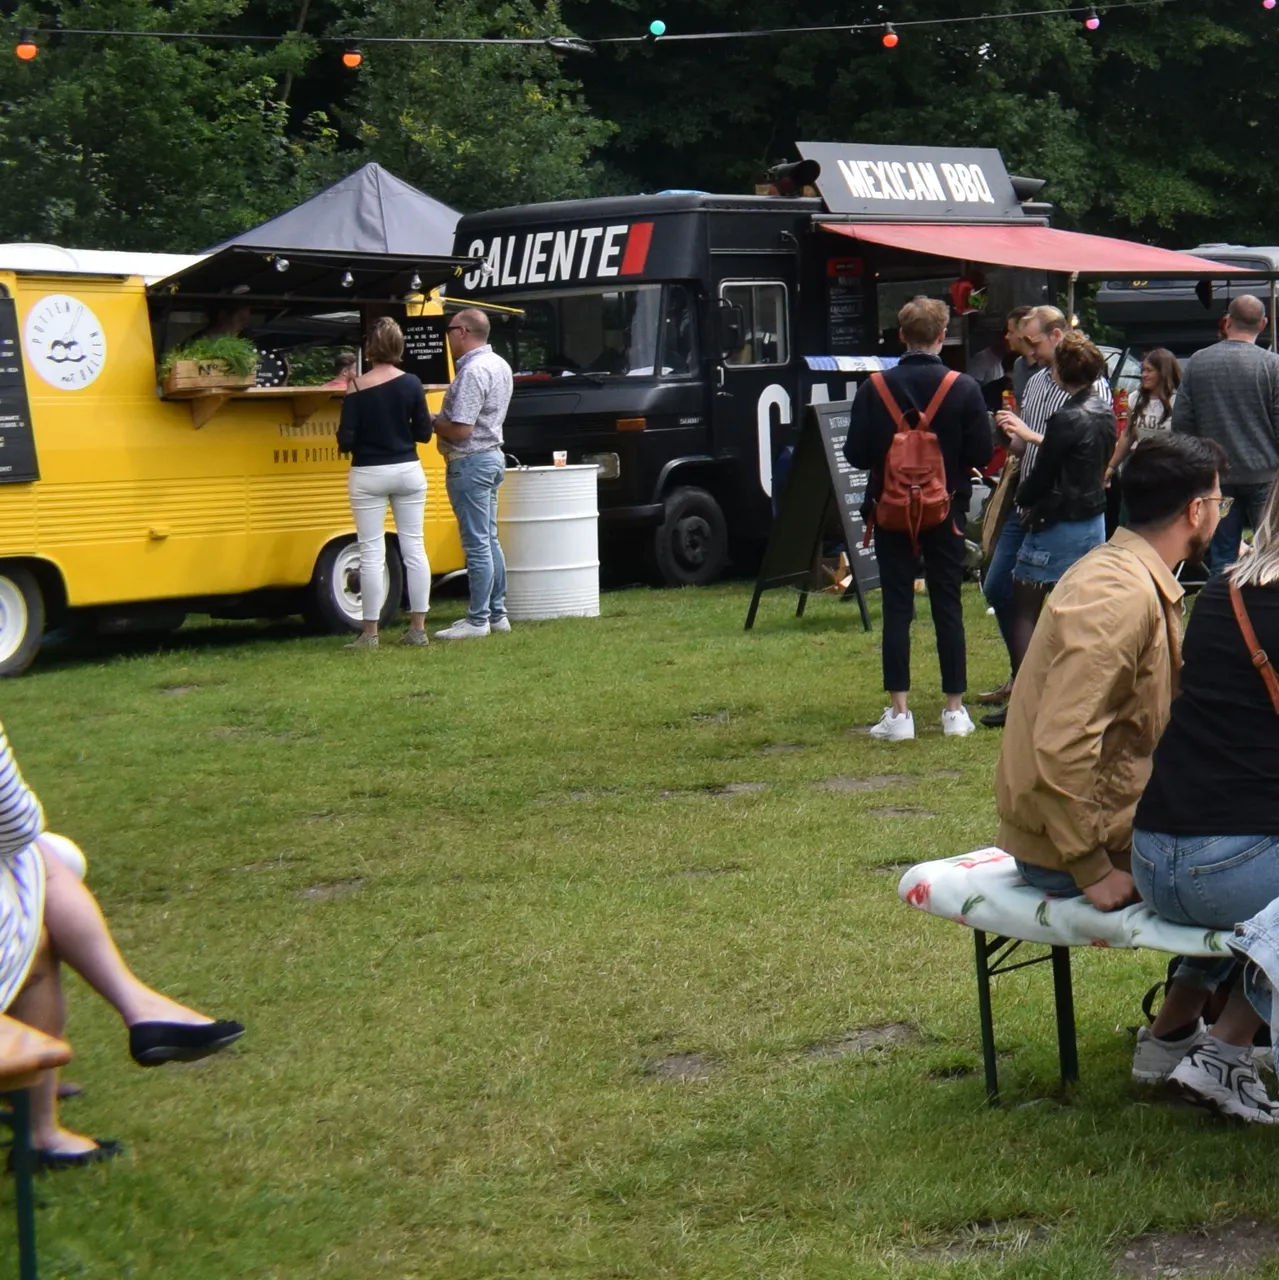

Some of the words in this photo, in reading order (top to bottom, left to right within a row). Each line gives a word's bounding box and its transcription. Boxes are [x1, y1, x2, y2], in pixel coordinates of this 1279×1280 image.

[837, 160, 947, 201] MEXICAN
[940, 163, 995, 204] BBQ
[464, 225, 629, 290] CALIENTE
